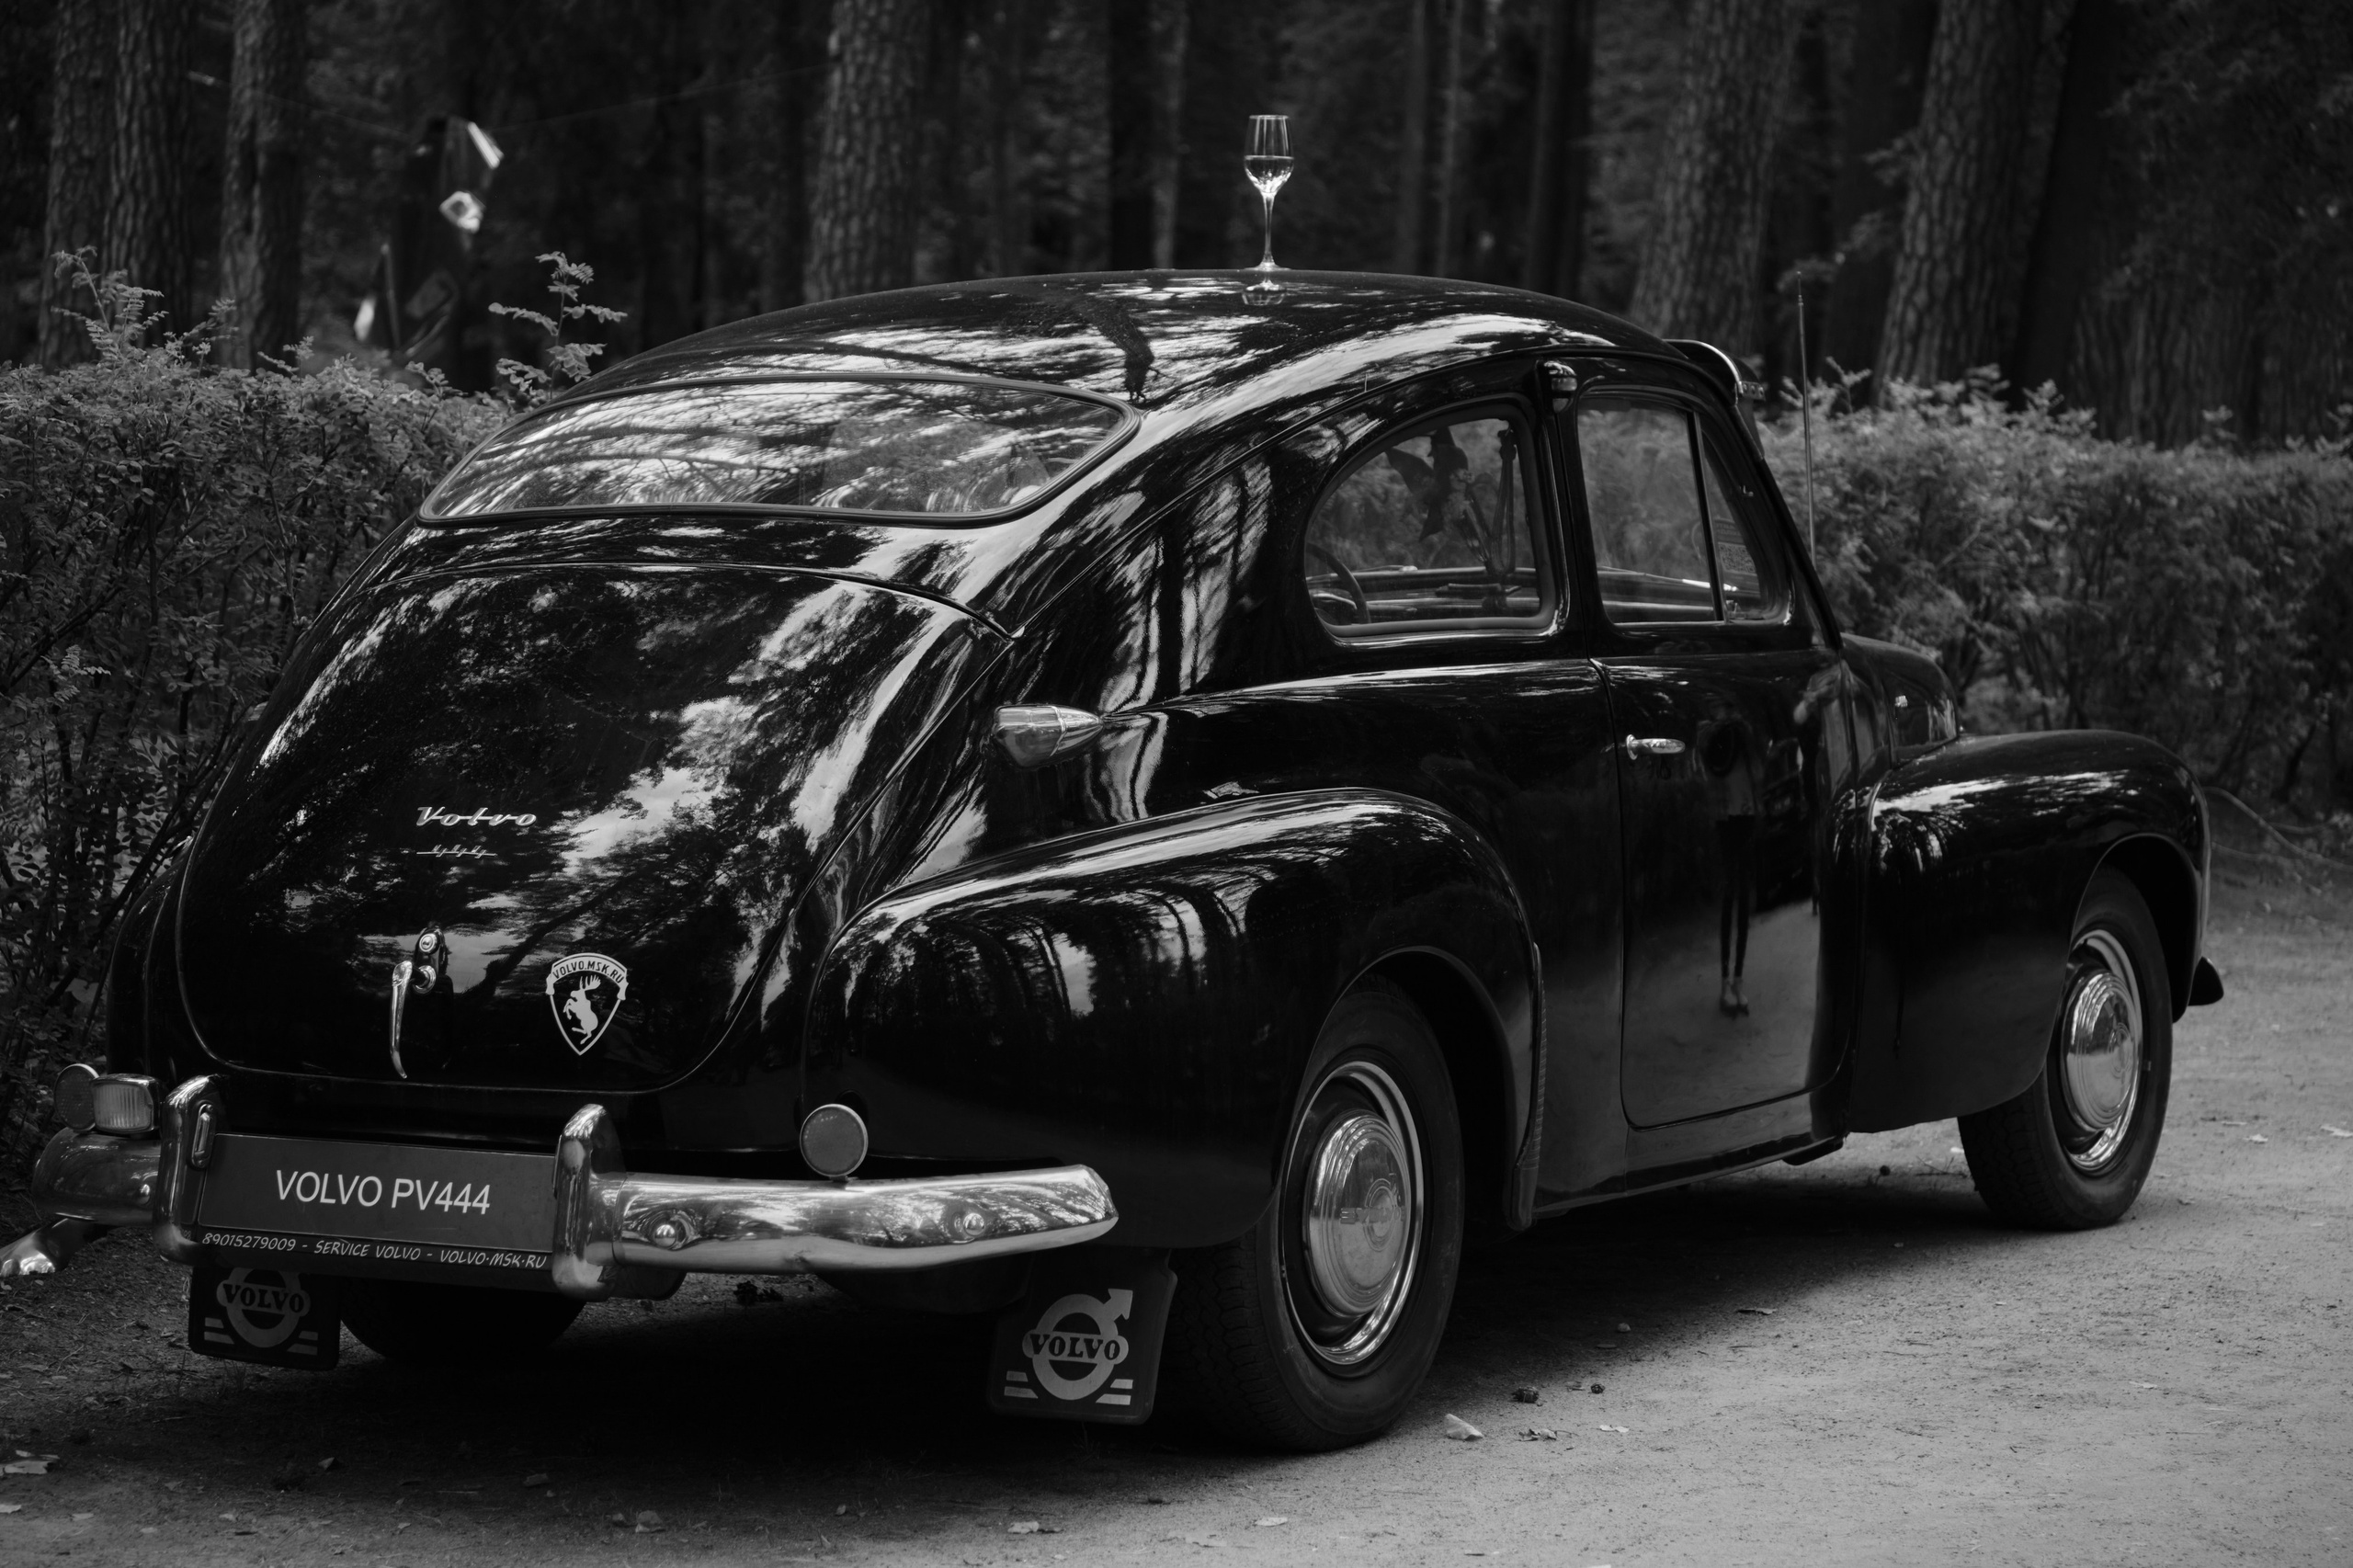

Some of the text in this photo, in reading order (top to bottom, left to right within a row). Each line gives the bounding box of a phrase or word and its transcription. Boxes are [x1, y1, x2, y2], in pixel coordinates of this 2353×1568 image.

[415, 806, 537, 826] Volvo
[552, 960, 625, 983] VOLVO.MSK.RU
[276, 1170, 491, 1215] VOLVO PV444
[202, 1233, 296, 1251] 89015279009
[313, 1240, 369, 1257] SERVICE
[375, 1244, 422, 1260] VOLVO
[222, 1283, 304, 1312] VOLVO
[1029, 1334, 1120, 1360] VOLVO
